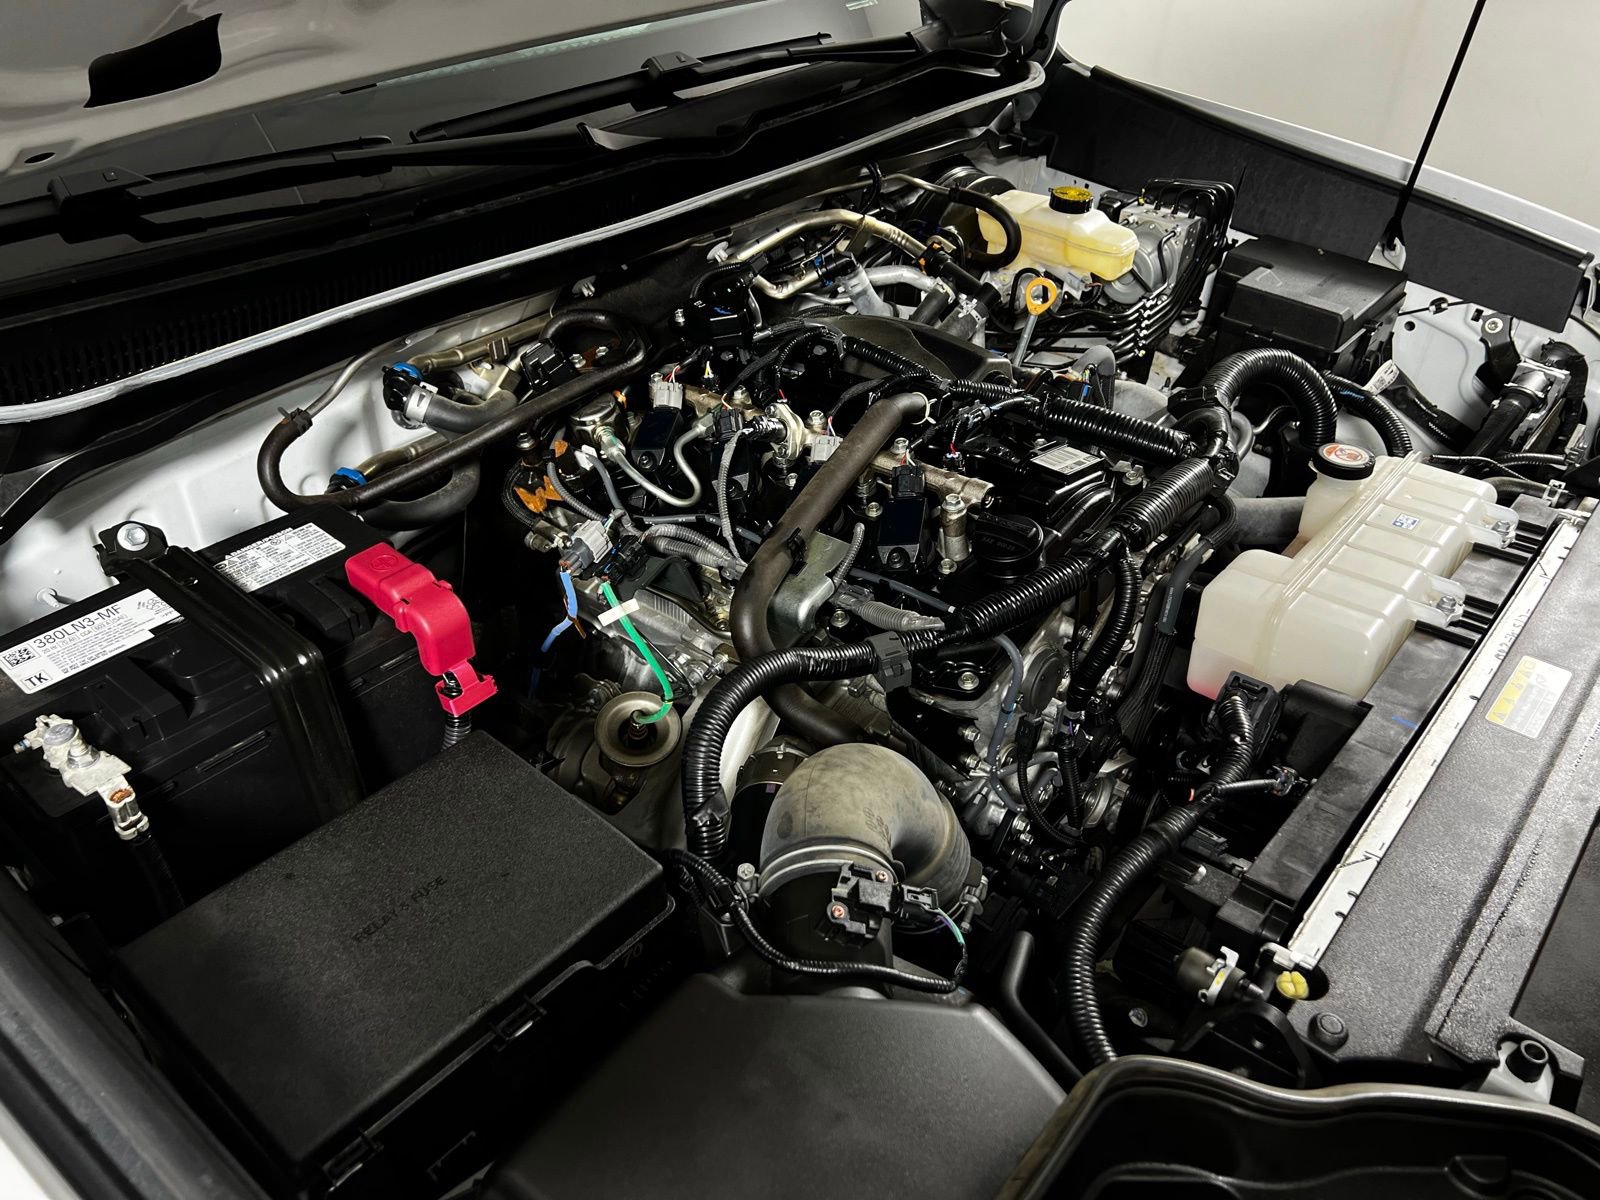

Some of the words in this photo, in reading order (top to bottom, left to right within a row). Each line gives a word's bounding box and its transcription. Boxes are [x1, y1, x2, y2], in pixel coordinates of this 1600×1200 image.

[33, 604, 122, 649] 380LN3-MF
[25, 672, 49, 688] TK
[352, 908, 398, 943] RELAY
[411, 875, 448, 903] FUSE
